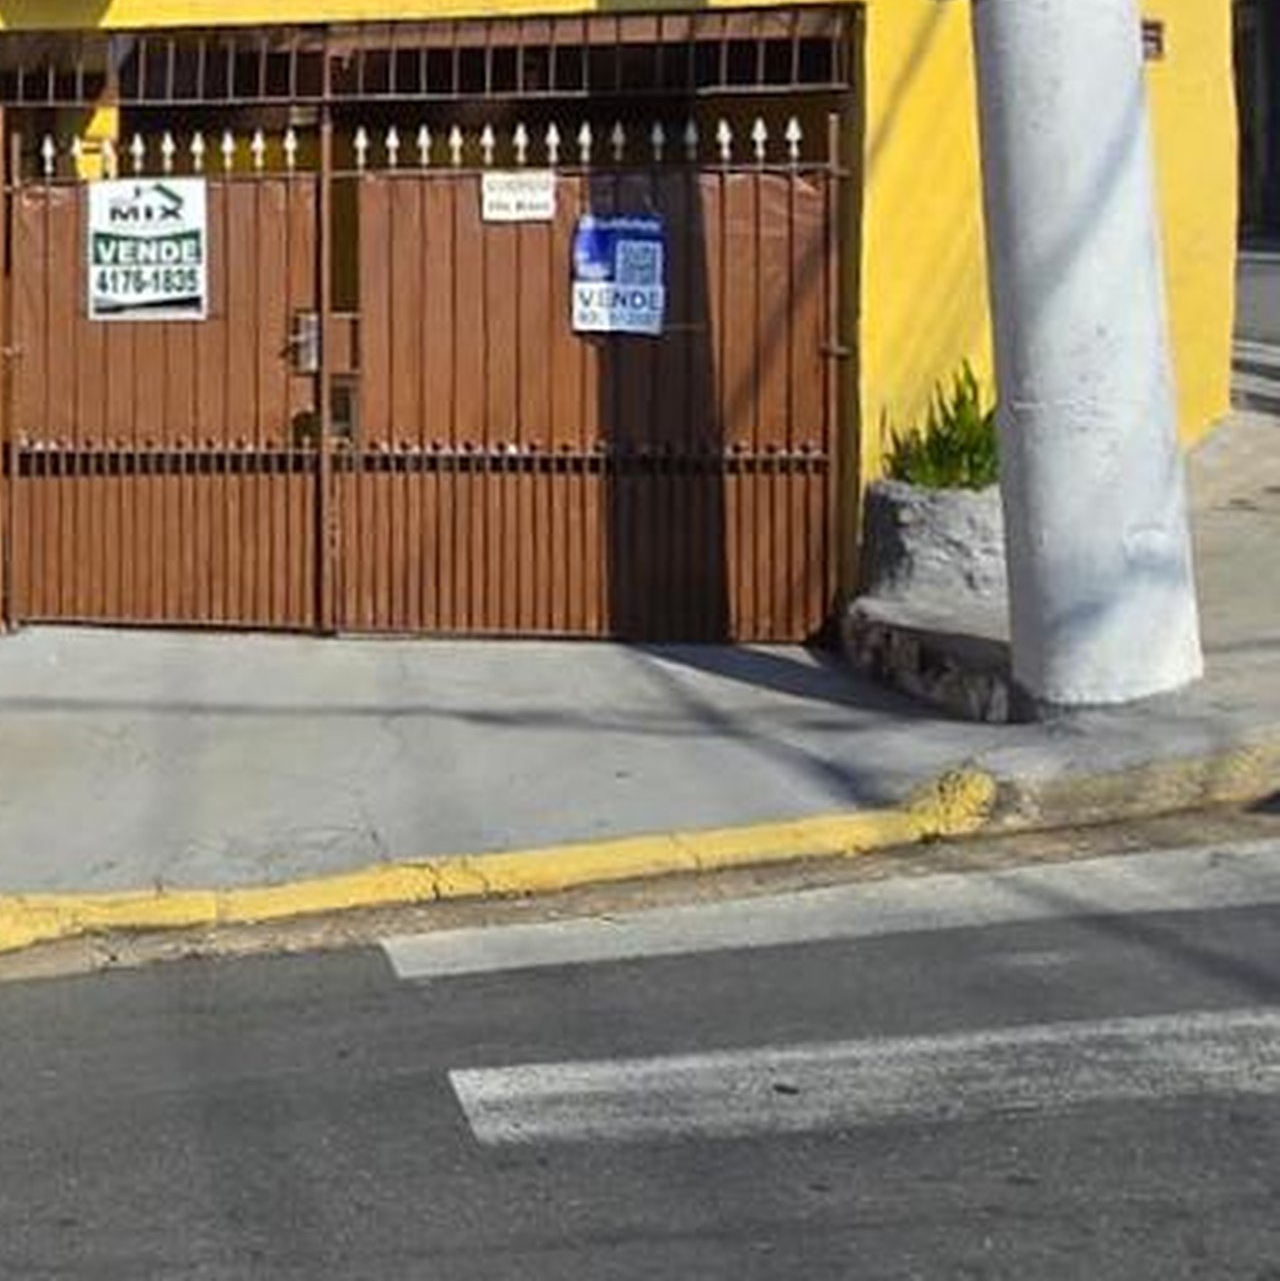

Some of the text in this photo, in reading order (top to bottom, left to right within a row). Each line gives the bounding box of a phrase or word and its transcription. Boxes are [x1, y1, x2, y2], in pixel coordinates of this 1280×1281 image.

[108, 205, 183, 222] MIX
[97, 239, 199, 262] VENDE
[578, 287, 664, 311] VENDE
